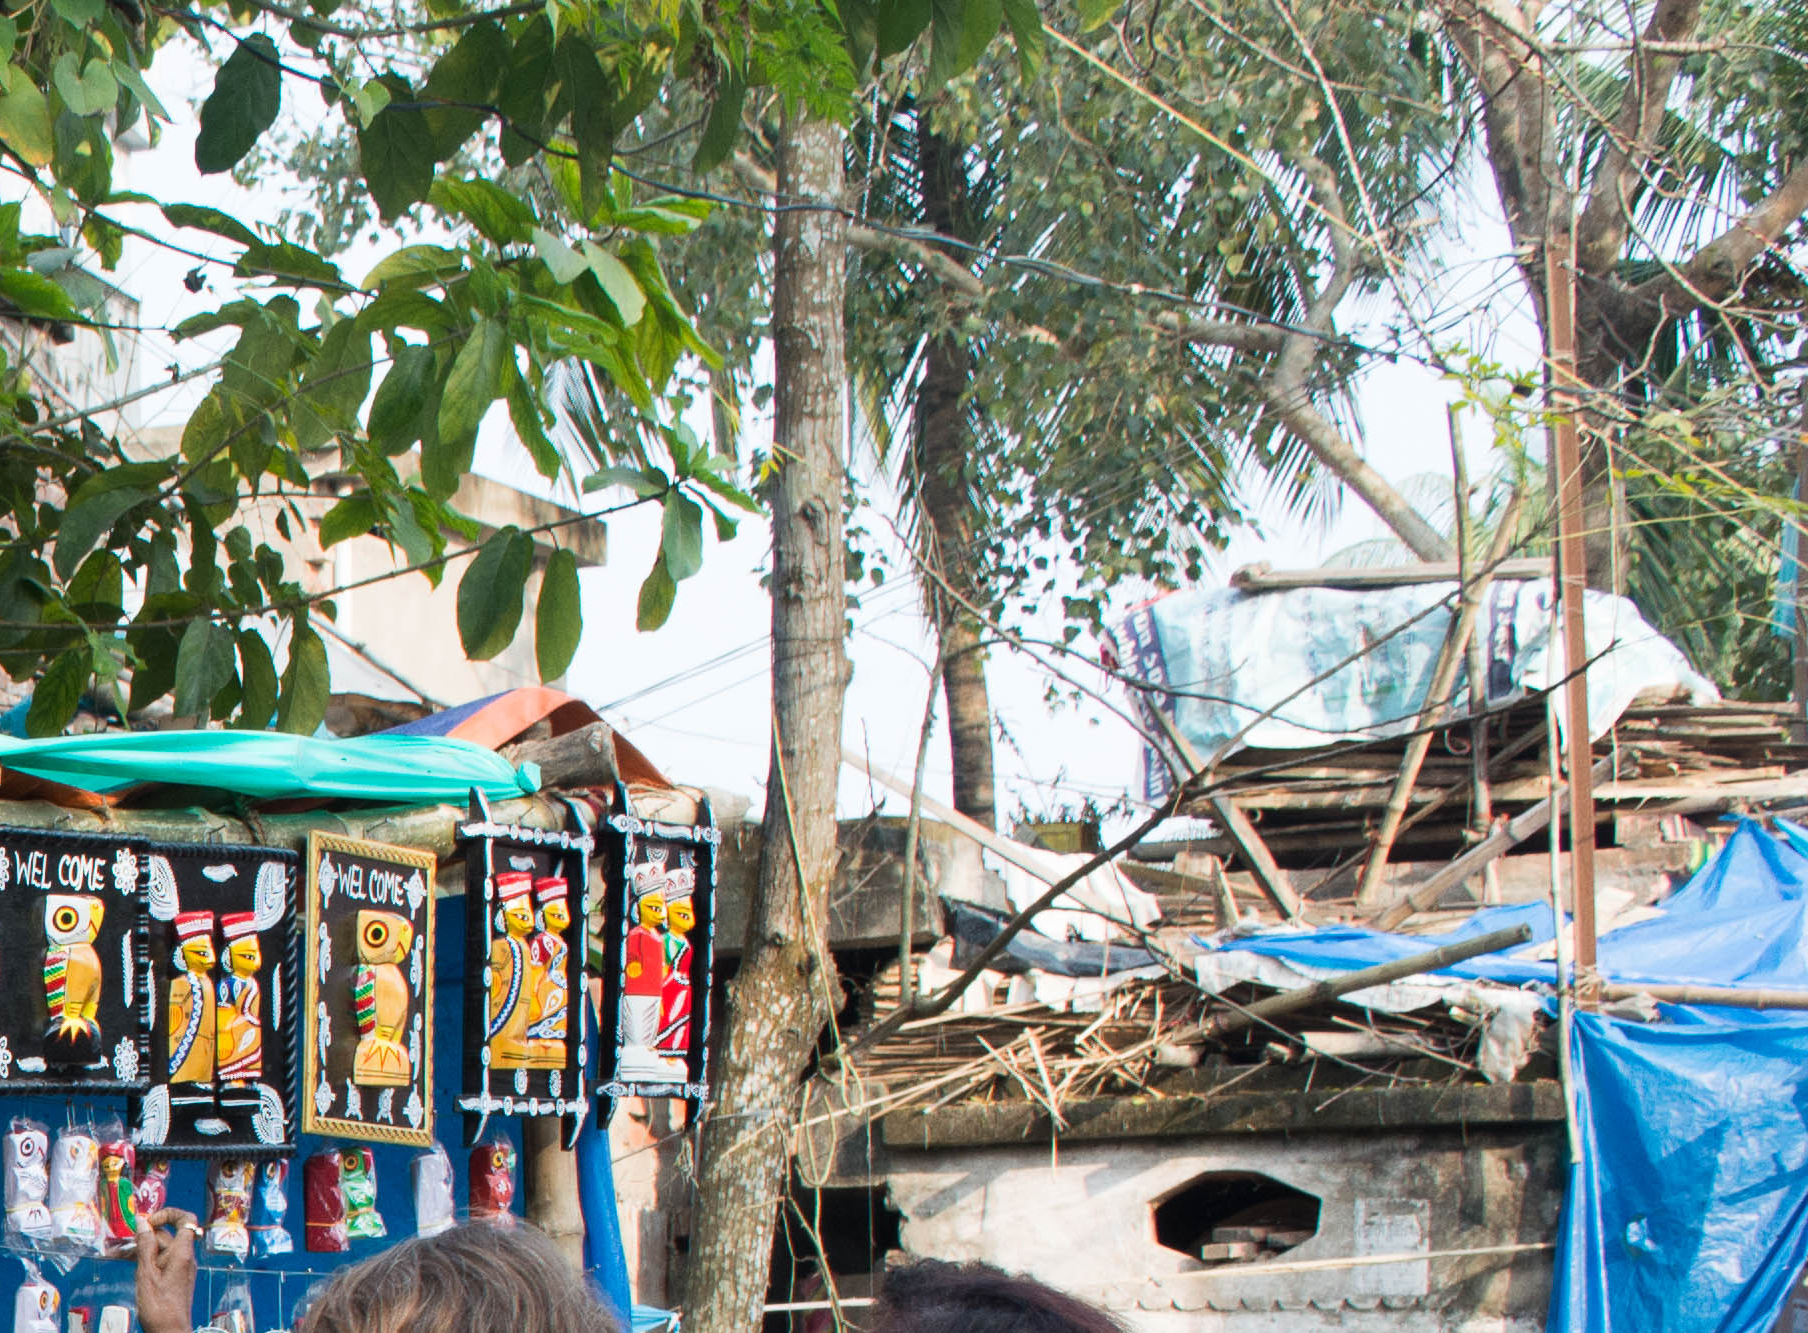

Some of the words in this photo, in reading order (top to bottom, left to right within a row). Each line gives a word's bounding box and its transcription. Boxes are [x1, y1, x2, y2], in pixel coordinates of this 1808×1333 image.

[14, 850, 52, 891] WEL
[58, 853, 107, 892] COME
[337, 863, 367, 900] WEL
[368, 868, 404, 907] COME
